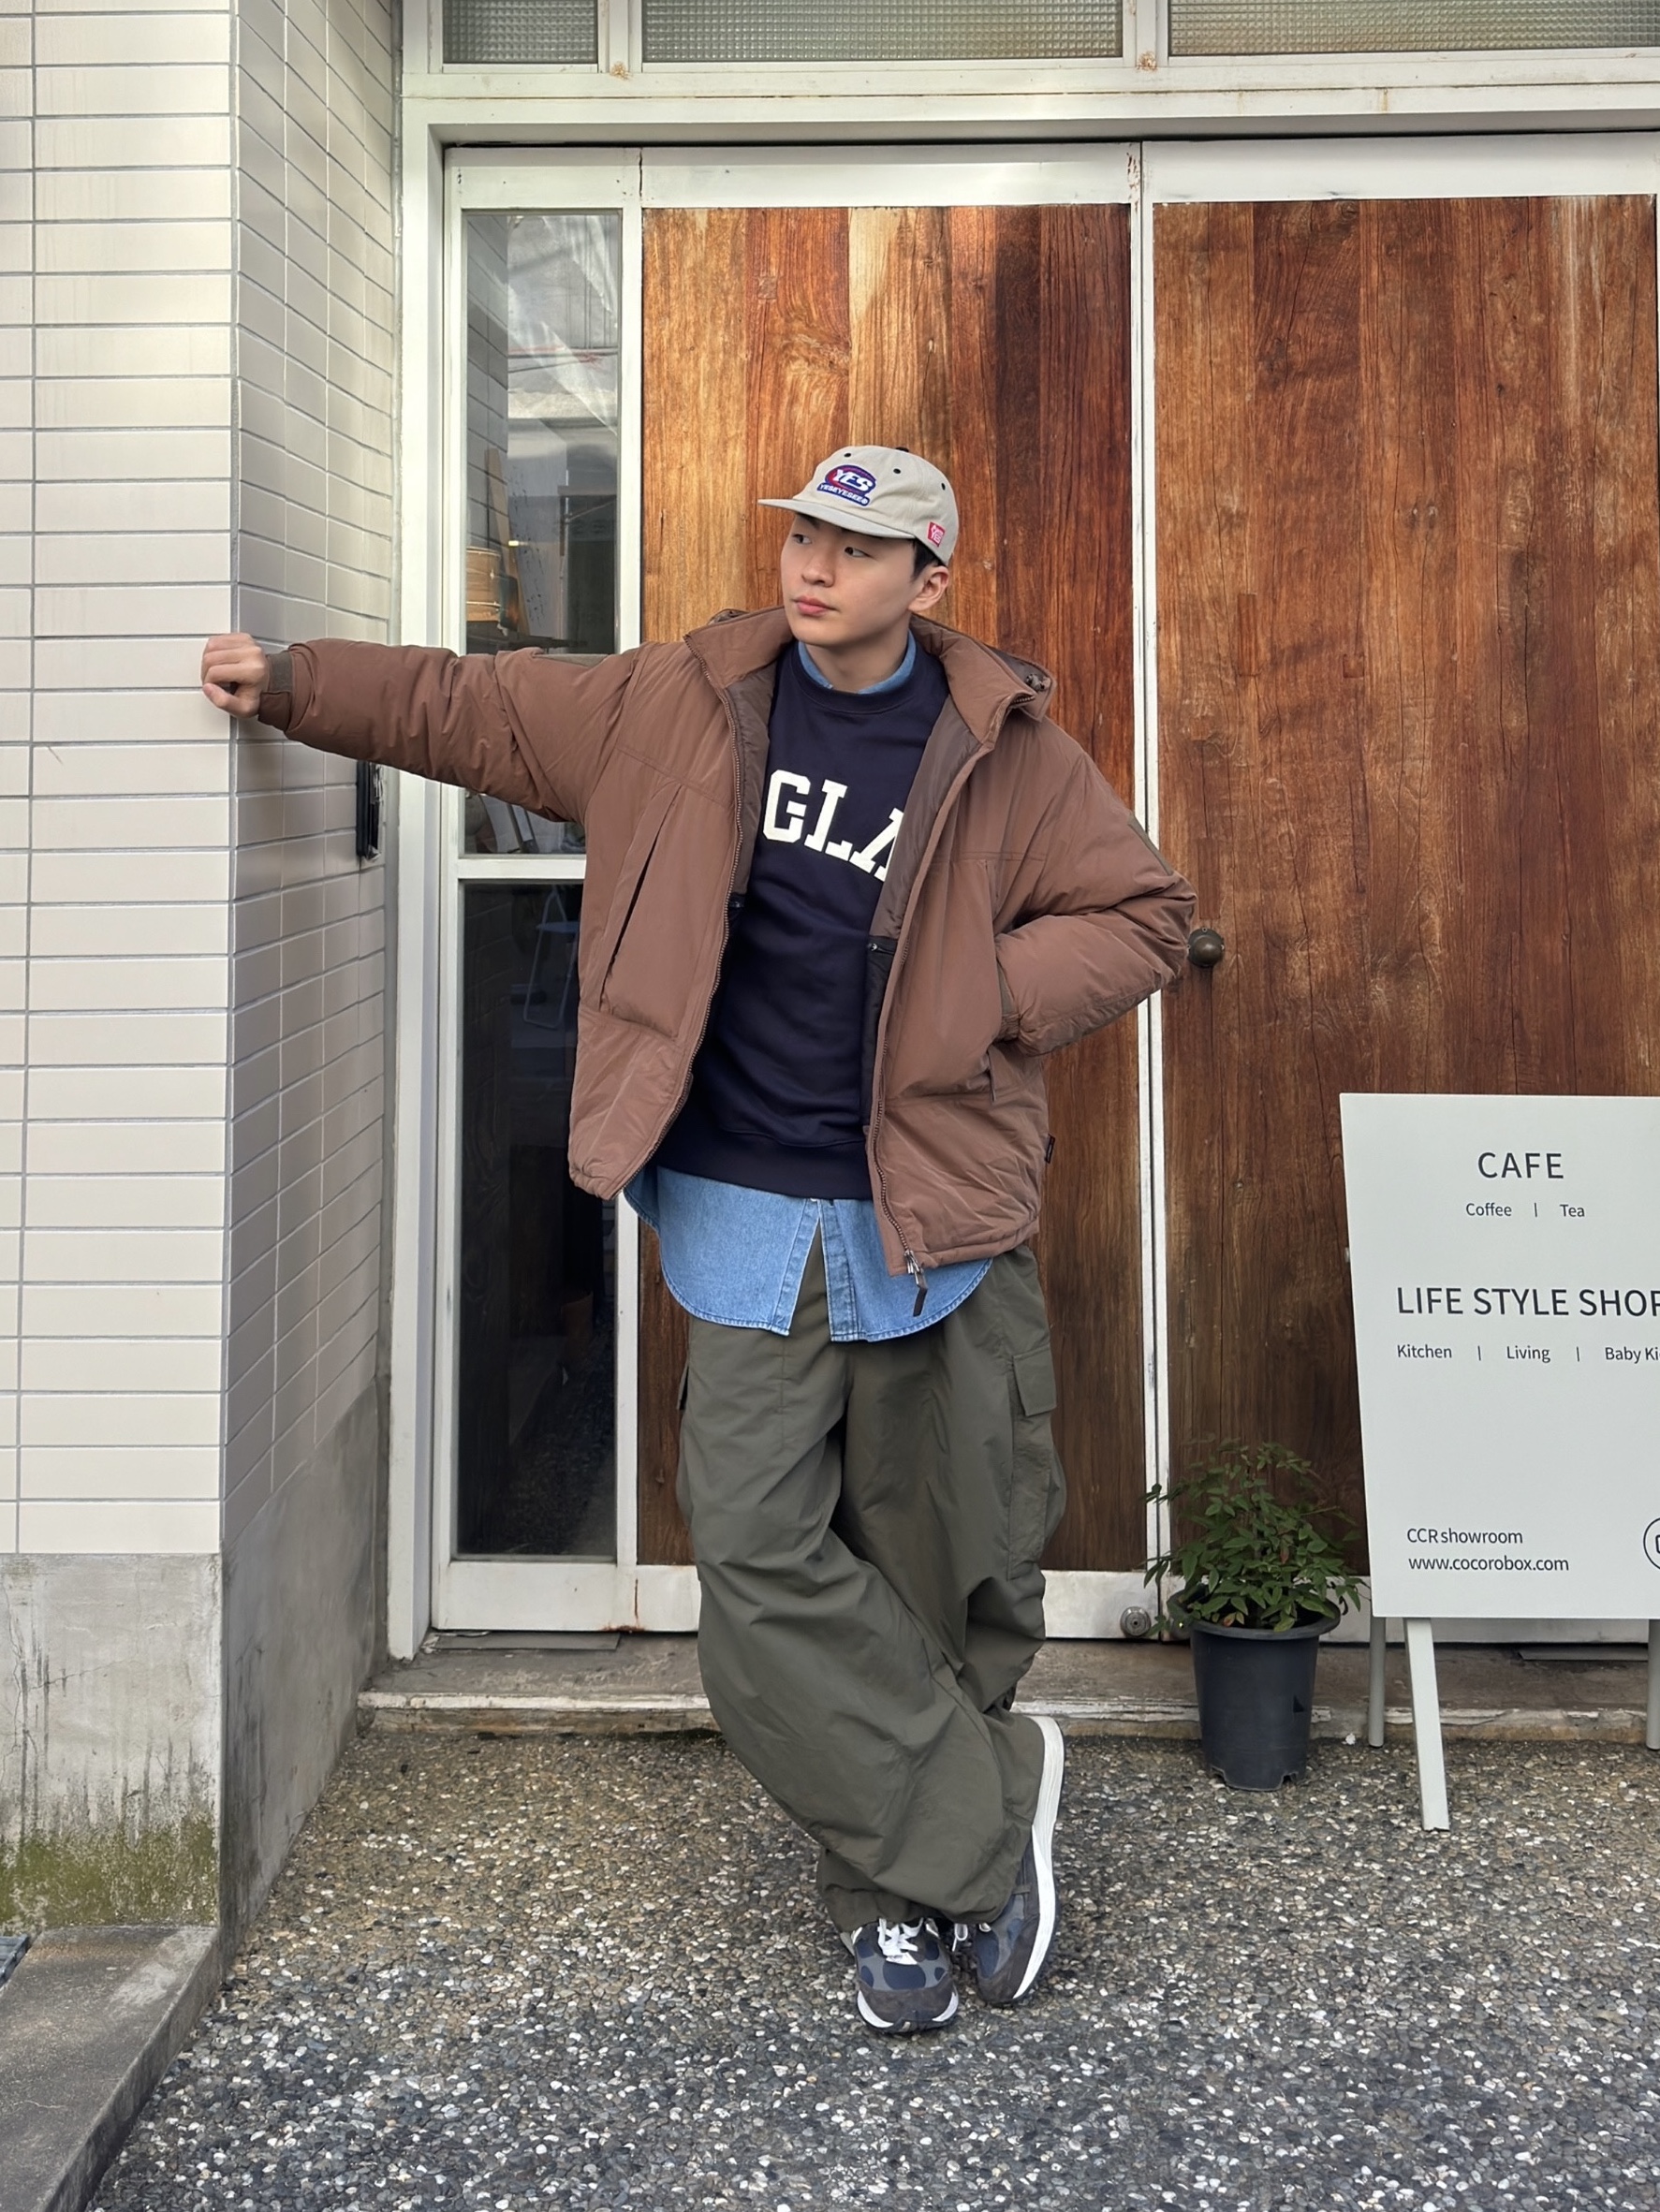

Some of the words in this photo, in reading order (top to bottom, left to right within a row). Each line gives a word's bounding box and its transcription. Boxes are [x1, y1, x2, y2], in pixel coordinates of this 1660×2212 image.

[832, 469, 874, 491] YES
[1477, 1151, 1565, 1179] CAFE
[1465, 1202, 1512, 1217] Coffee
[1559, 1204, 1585, 1218] Tea
[1397, 1286, 1464, 1315] LIFE
[1473, 1287, 1569, 1316] STYLE
[1397, 1343, 1452, 1359] Kitchen
[1506, 1344, 1551, 1364] Living
[1605, 1345, 1641, 1365] Baby
[1644, 1346, 1660, 1361] Ki
[1406, 1528, 1439, 1544] CCR
[1440, 1527, 1523, 1545] showroom
[1408, 1554, 1569, 1572] www.cocorobox.com
